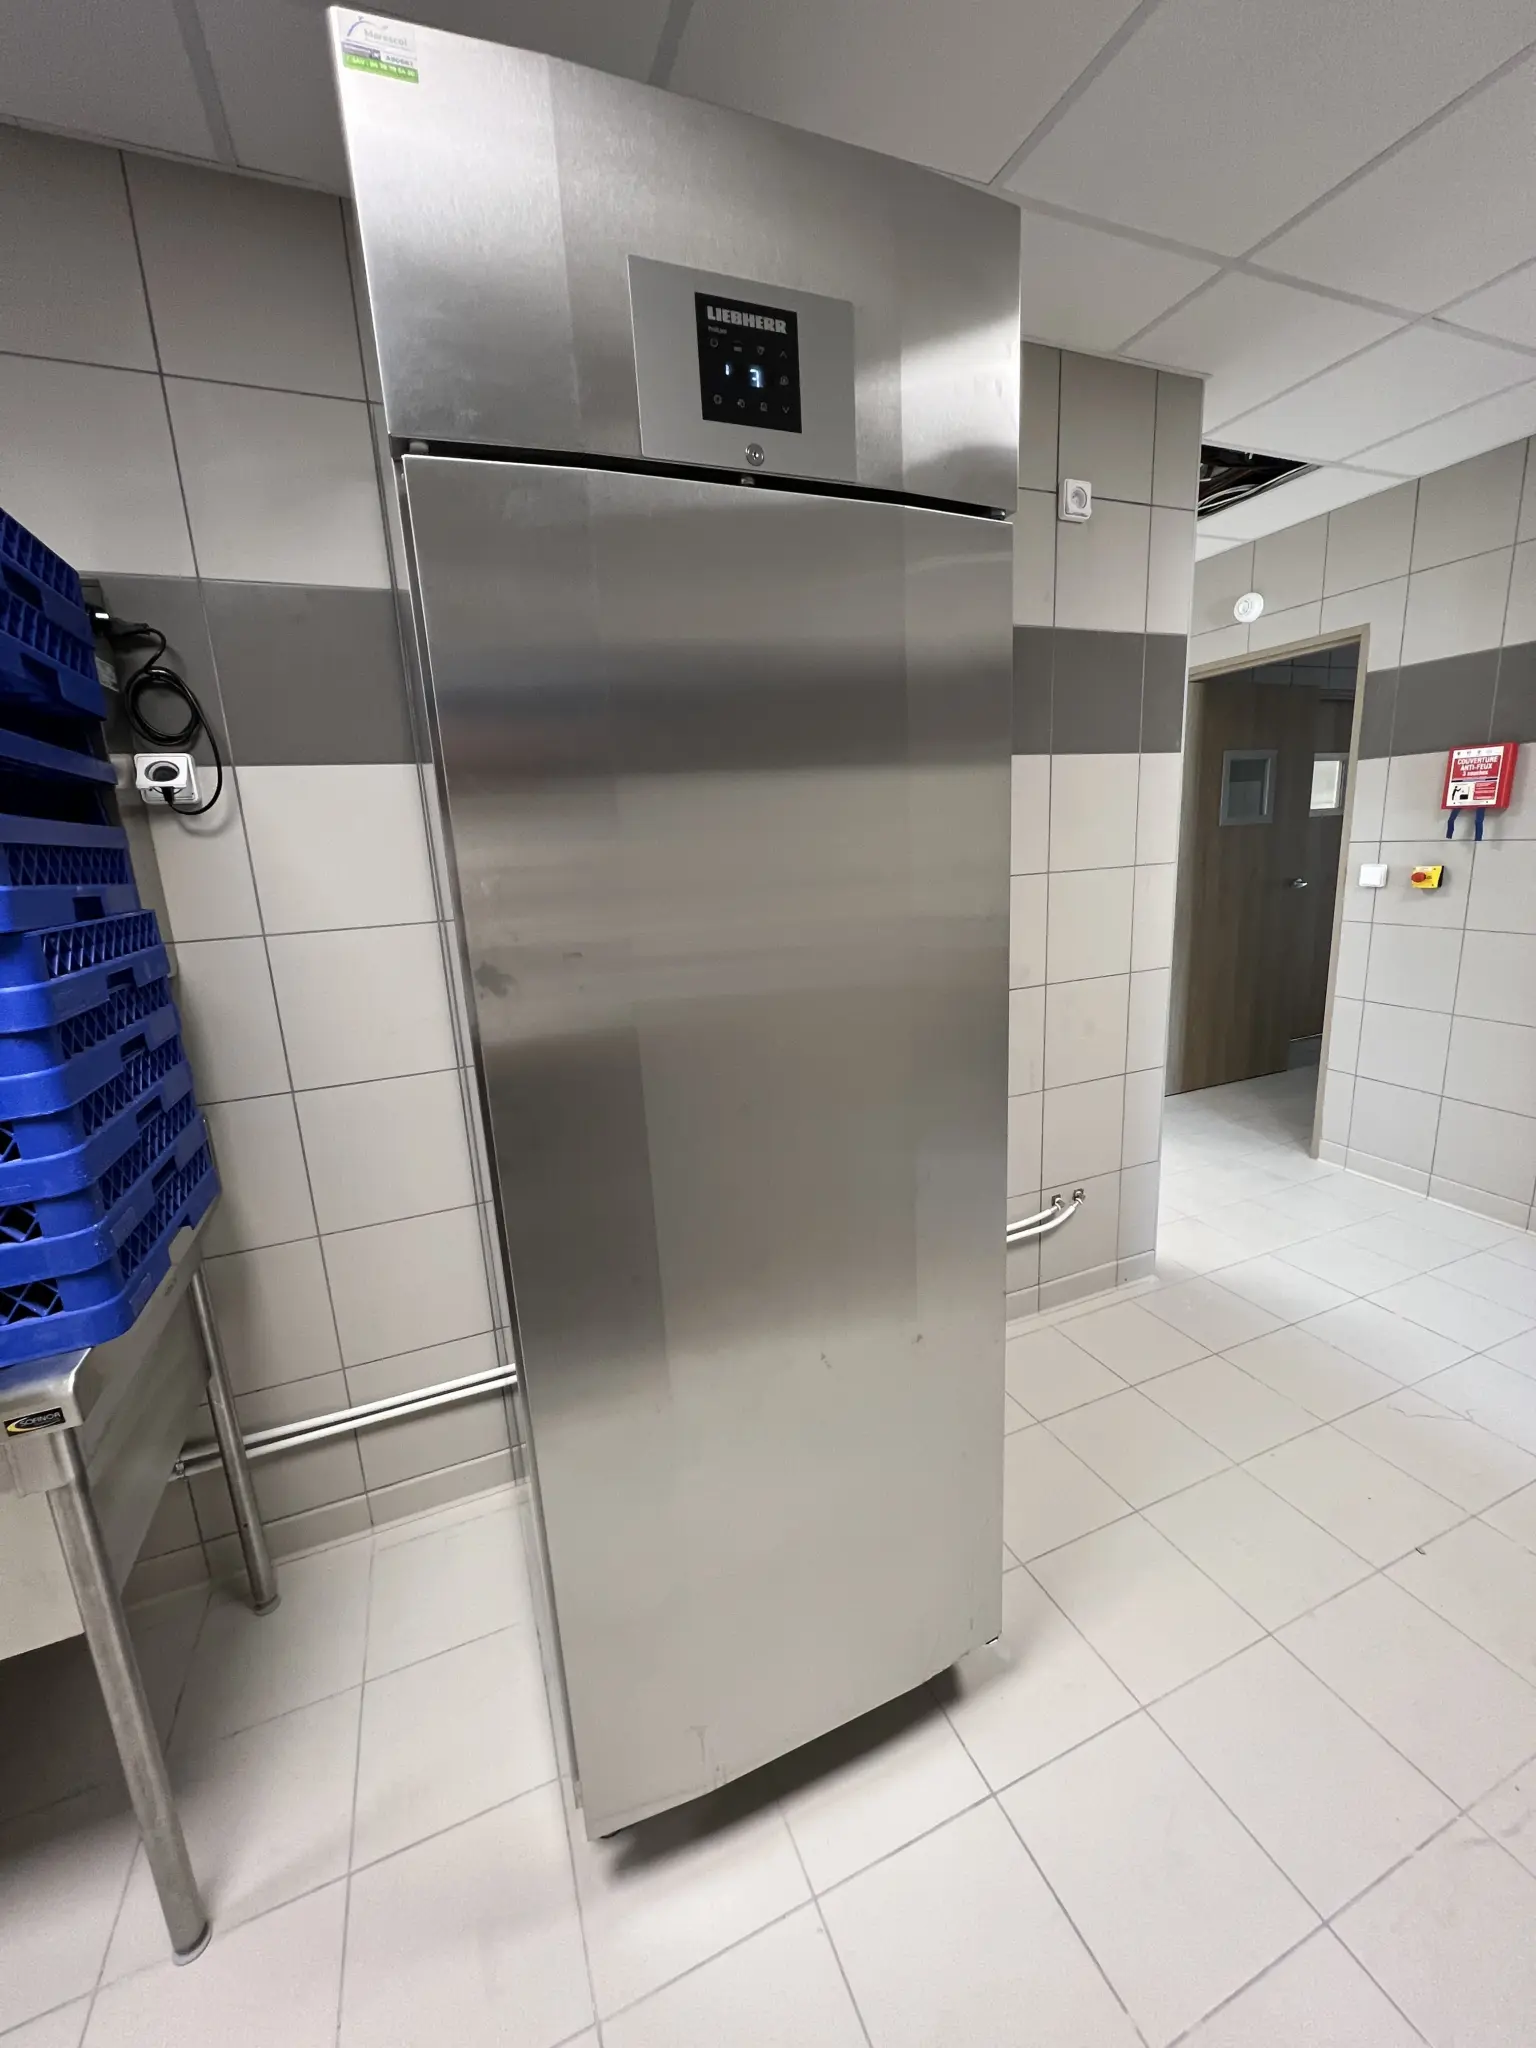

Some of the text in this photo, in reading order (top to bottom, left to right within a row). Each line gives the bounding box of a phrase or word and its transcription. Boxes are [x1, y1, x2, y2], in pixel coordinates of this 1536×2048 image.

[706, 305, 788, 335] LIEBHERR
[1457, 756, 1498, 765] COUVERTURE
[1460, 763, 1493, 771] ANTI-FEUX
